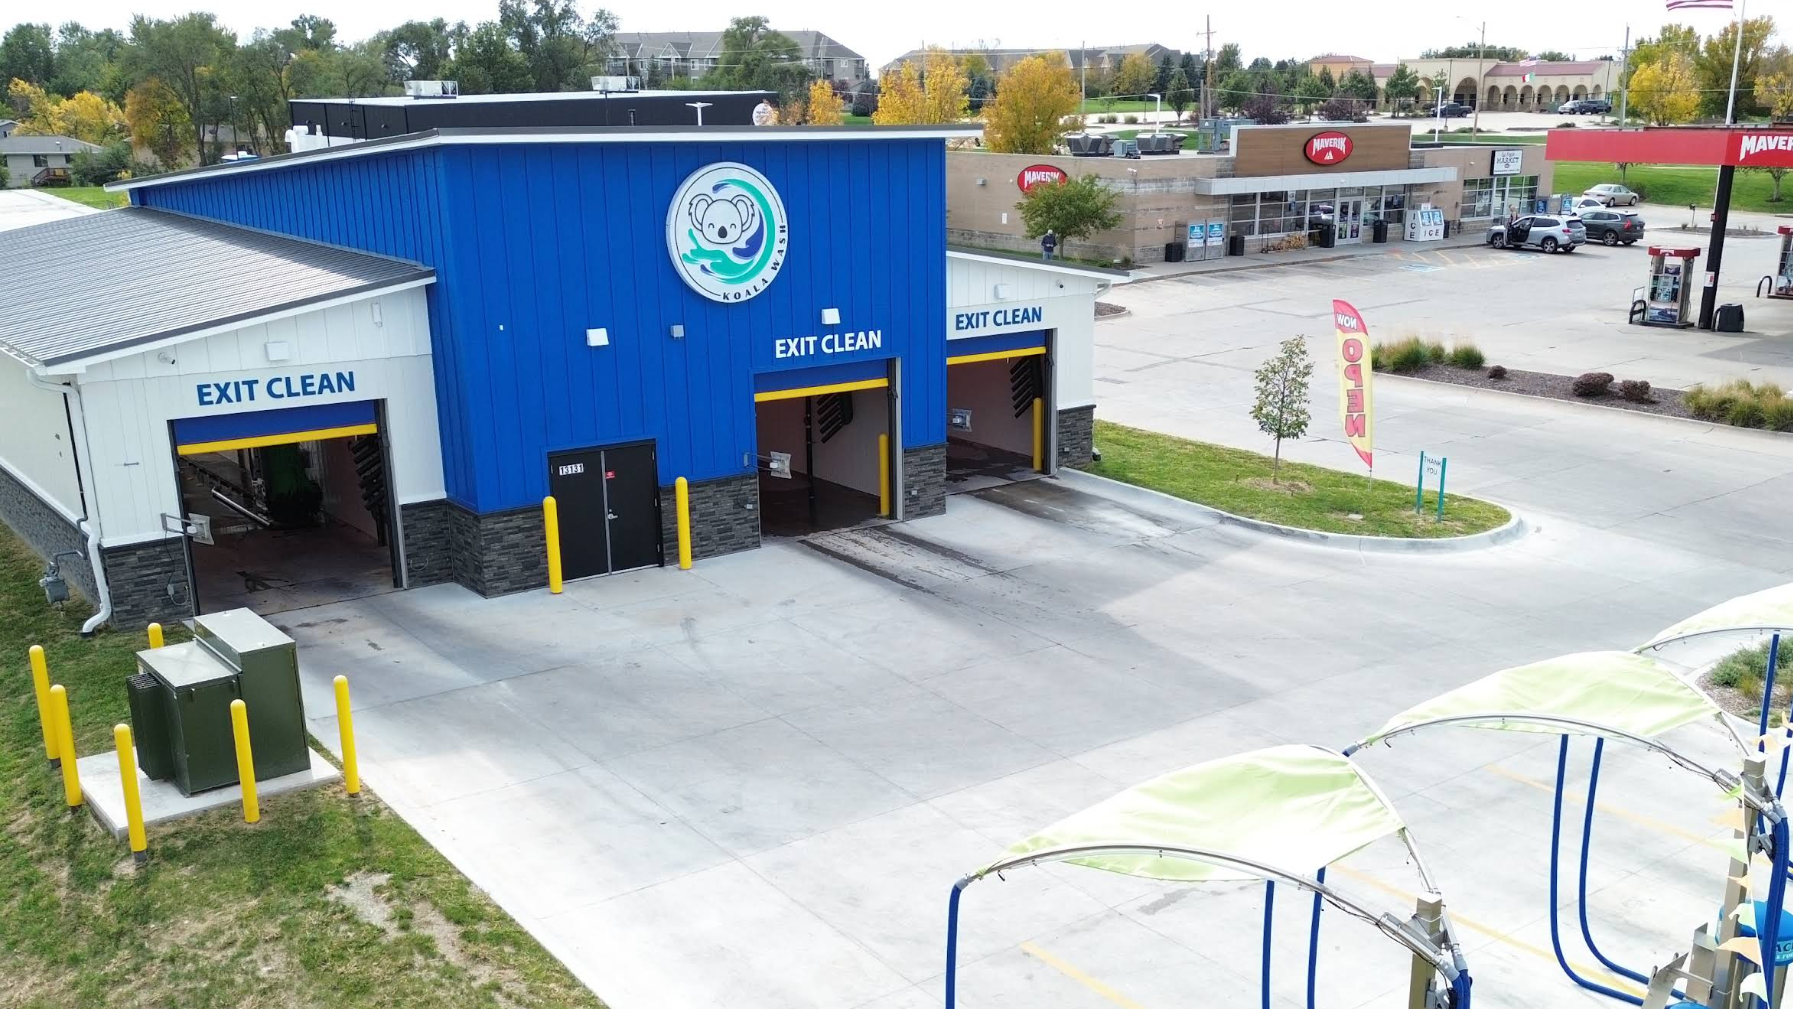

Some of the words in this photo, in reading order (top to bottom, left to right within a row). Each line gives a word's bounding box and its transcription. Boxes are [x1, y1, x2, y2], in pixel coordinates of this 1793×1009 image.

[1312, 137, 1346, 156] MAVERIK
[1424, 228, 1441, 237] ICE
[722, 278, 769, 301] KOALA
[770, 224, 787, 272] WASH
[954, 311, 990, 331] EXIT
[993, 306, 1042, 327] CLEAN
[775, 336, 818, 359] EXIT
[821, 330, 882, 354] CLEAN
[196, 379, 259, 406] EXIT
[266, 371, 355, 399] CLEAN
[559, 463, 584, 476] 13131
[1424, 456, 1441, 467] THANK
[1427, 467, 1438, 475] YOU
